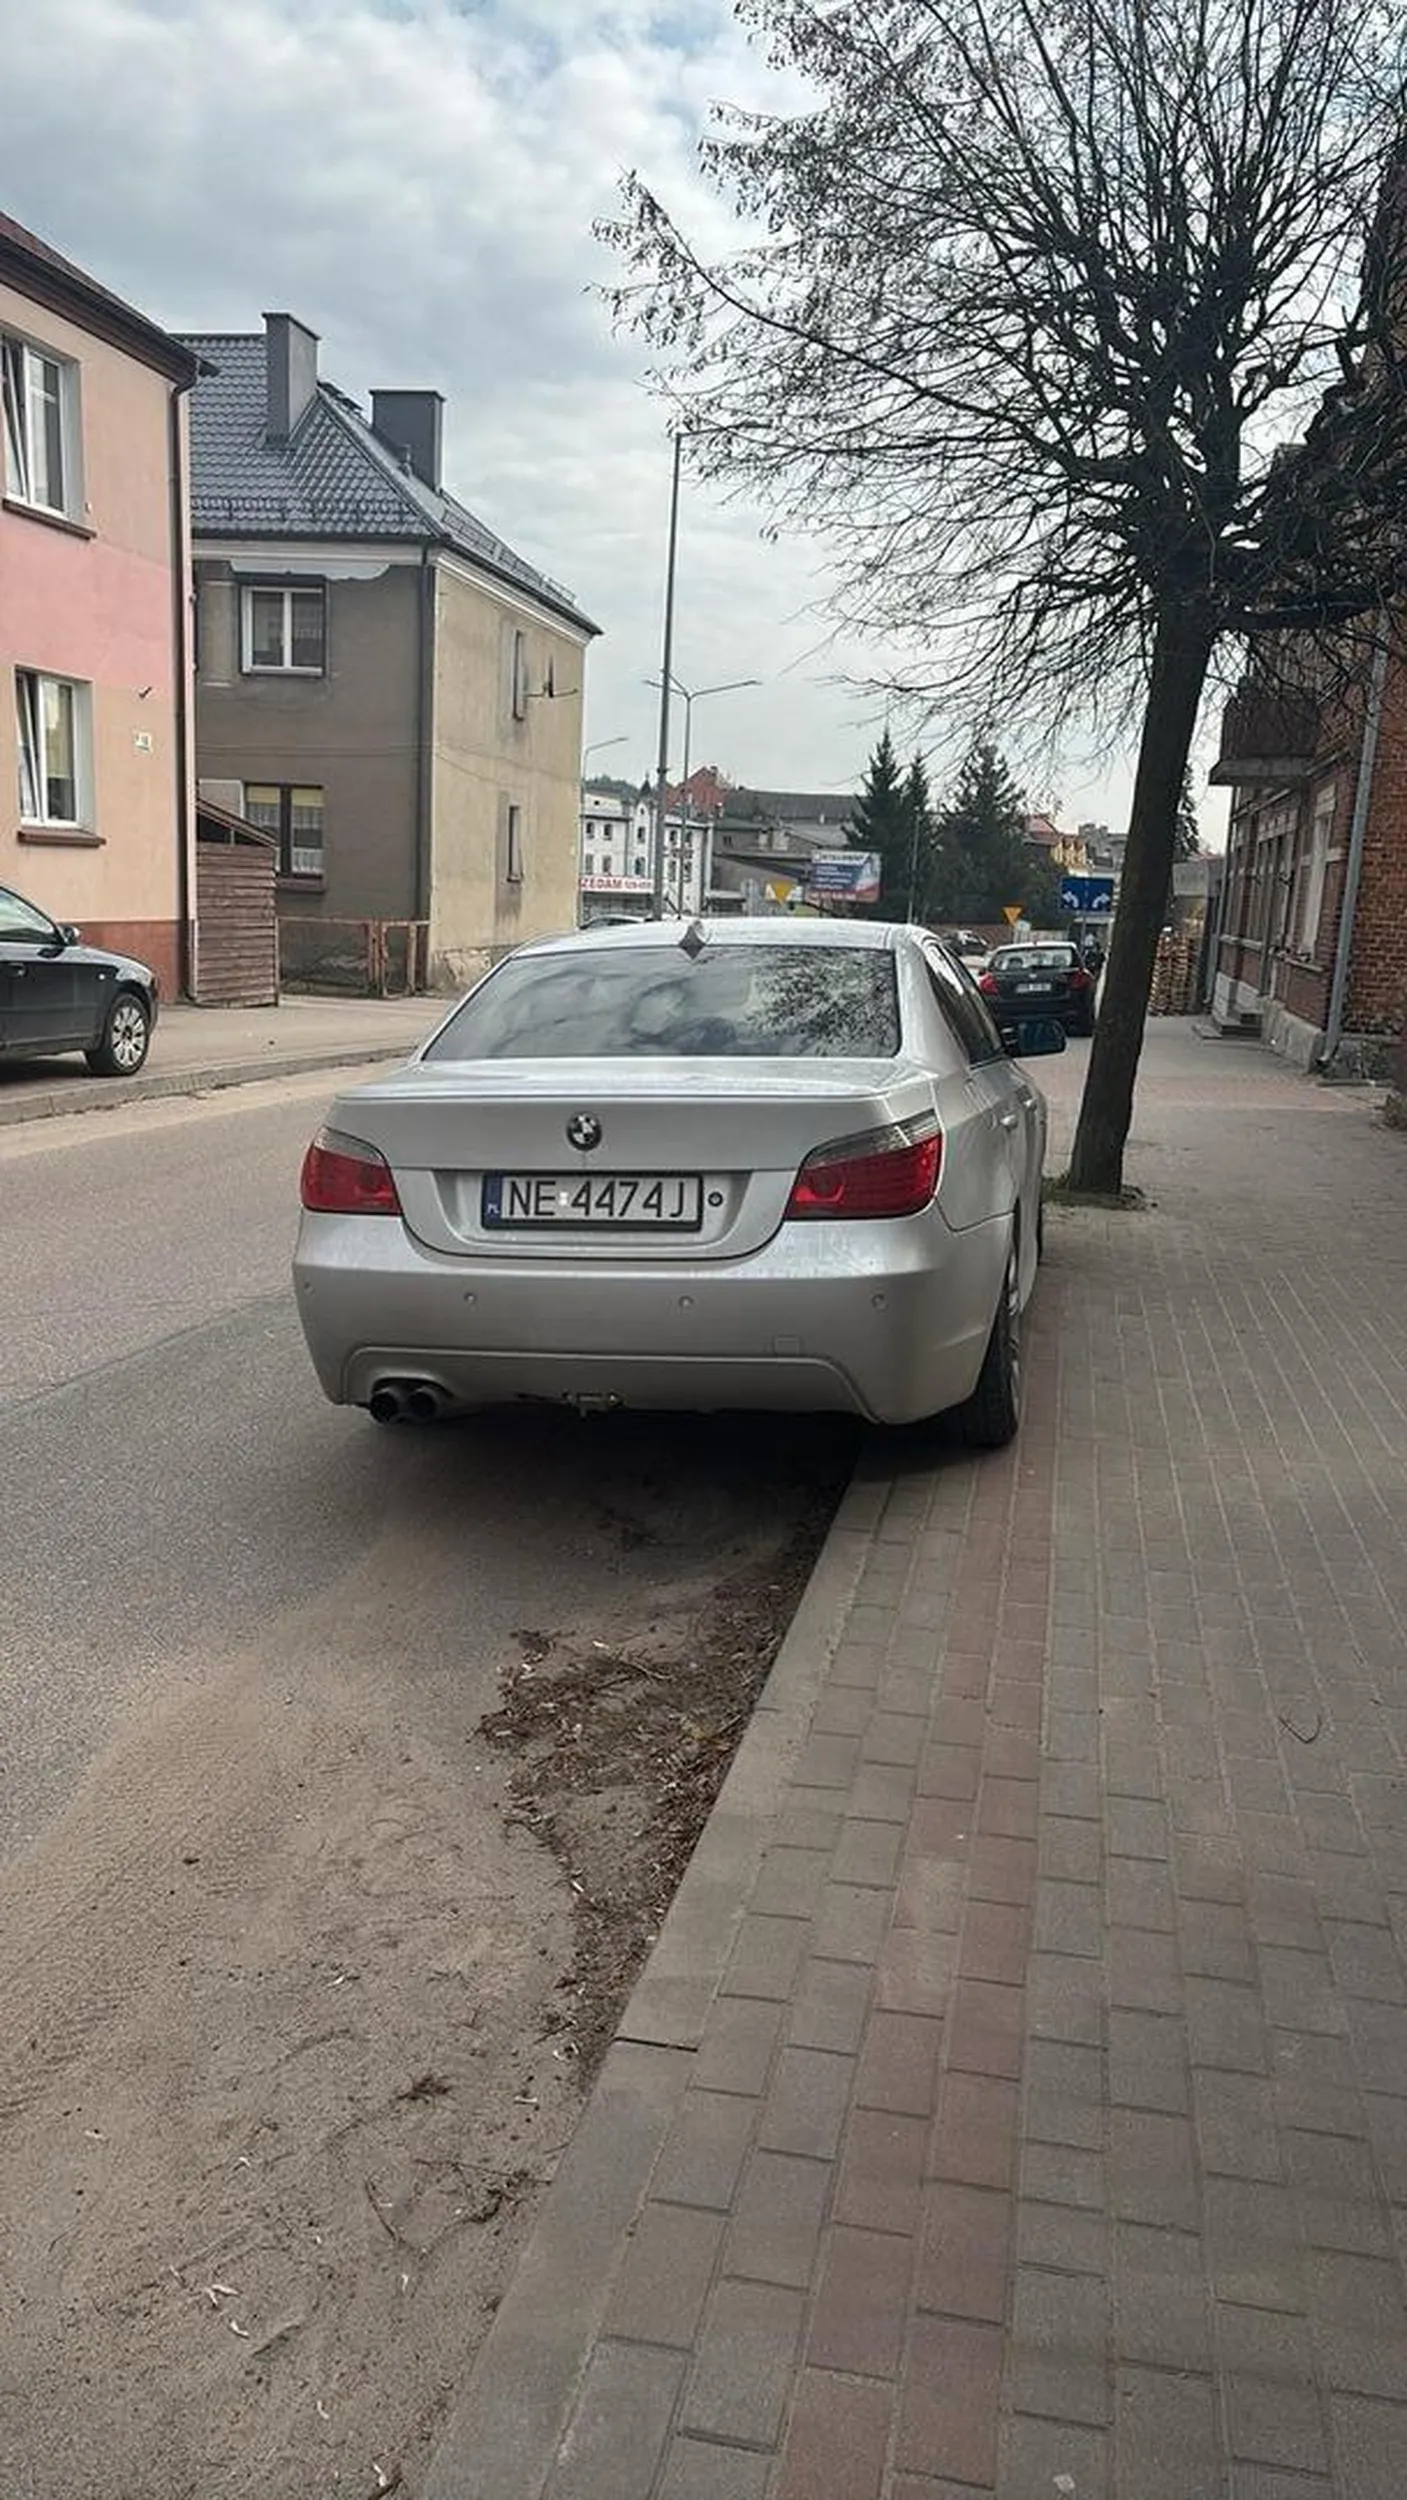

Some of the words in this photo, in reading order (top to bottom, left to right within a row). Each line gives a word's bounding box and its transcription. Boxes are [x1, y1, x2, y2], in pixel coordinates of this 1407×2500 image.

[486, 1203, 500, 1215] PL
[508, 1180, 557, 1217] NE
[570, 1180, 685, 1218] 4474J
